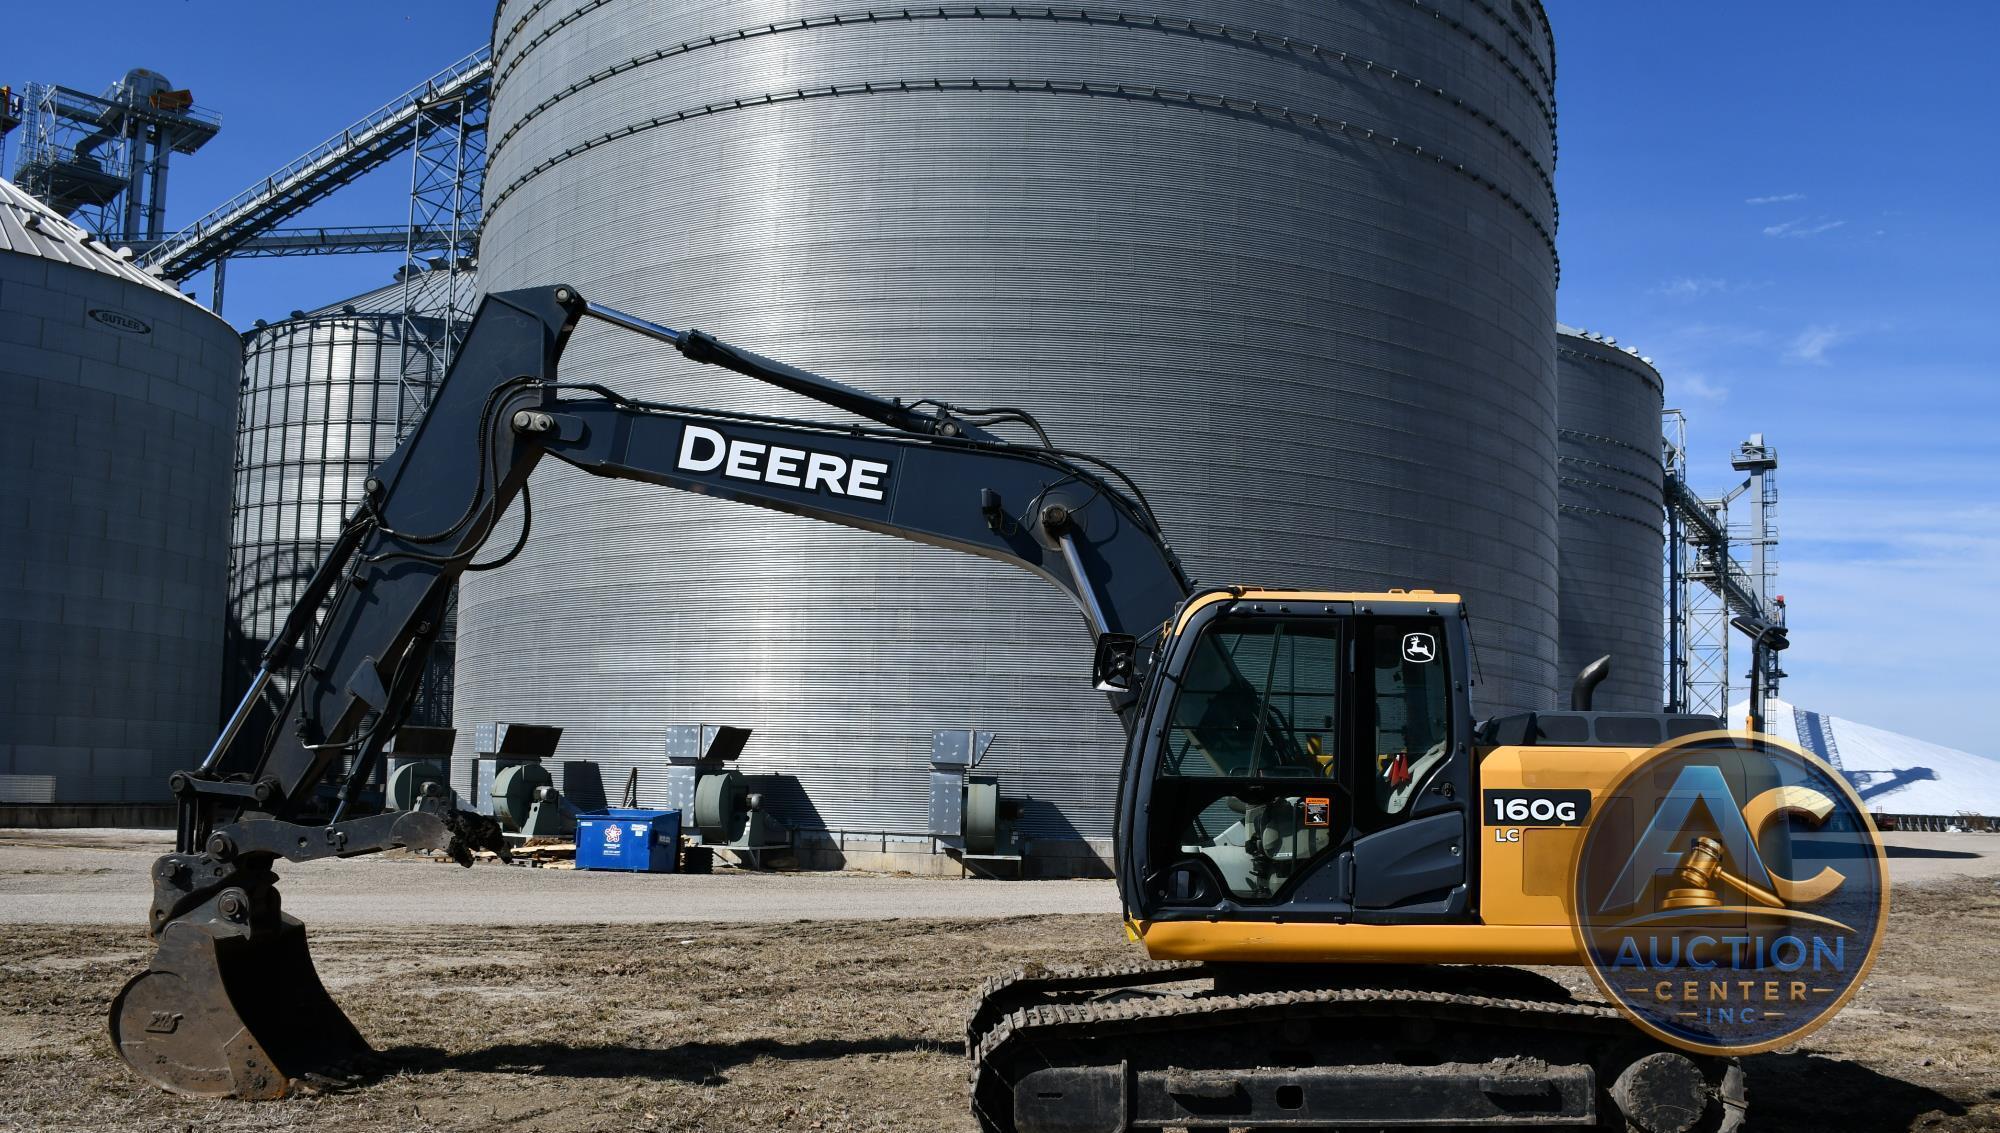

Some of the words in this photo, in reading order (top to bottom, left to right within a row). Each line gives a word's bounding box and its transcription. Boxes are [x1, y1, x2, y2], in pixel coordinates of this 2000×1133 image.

[677, 424, 889, 501] DEERE
[1493, 798, 1576, 821] 160G
[1495, 829, 1519, 842] LC
